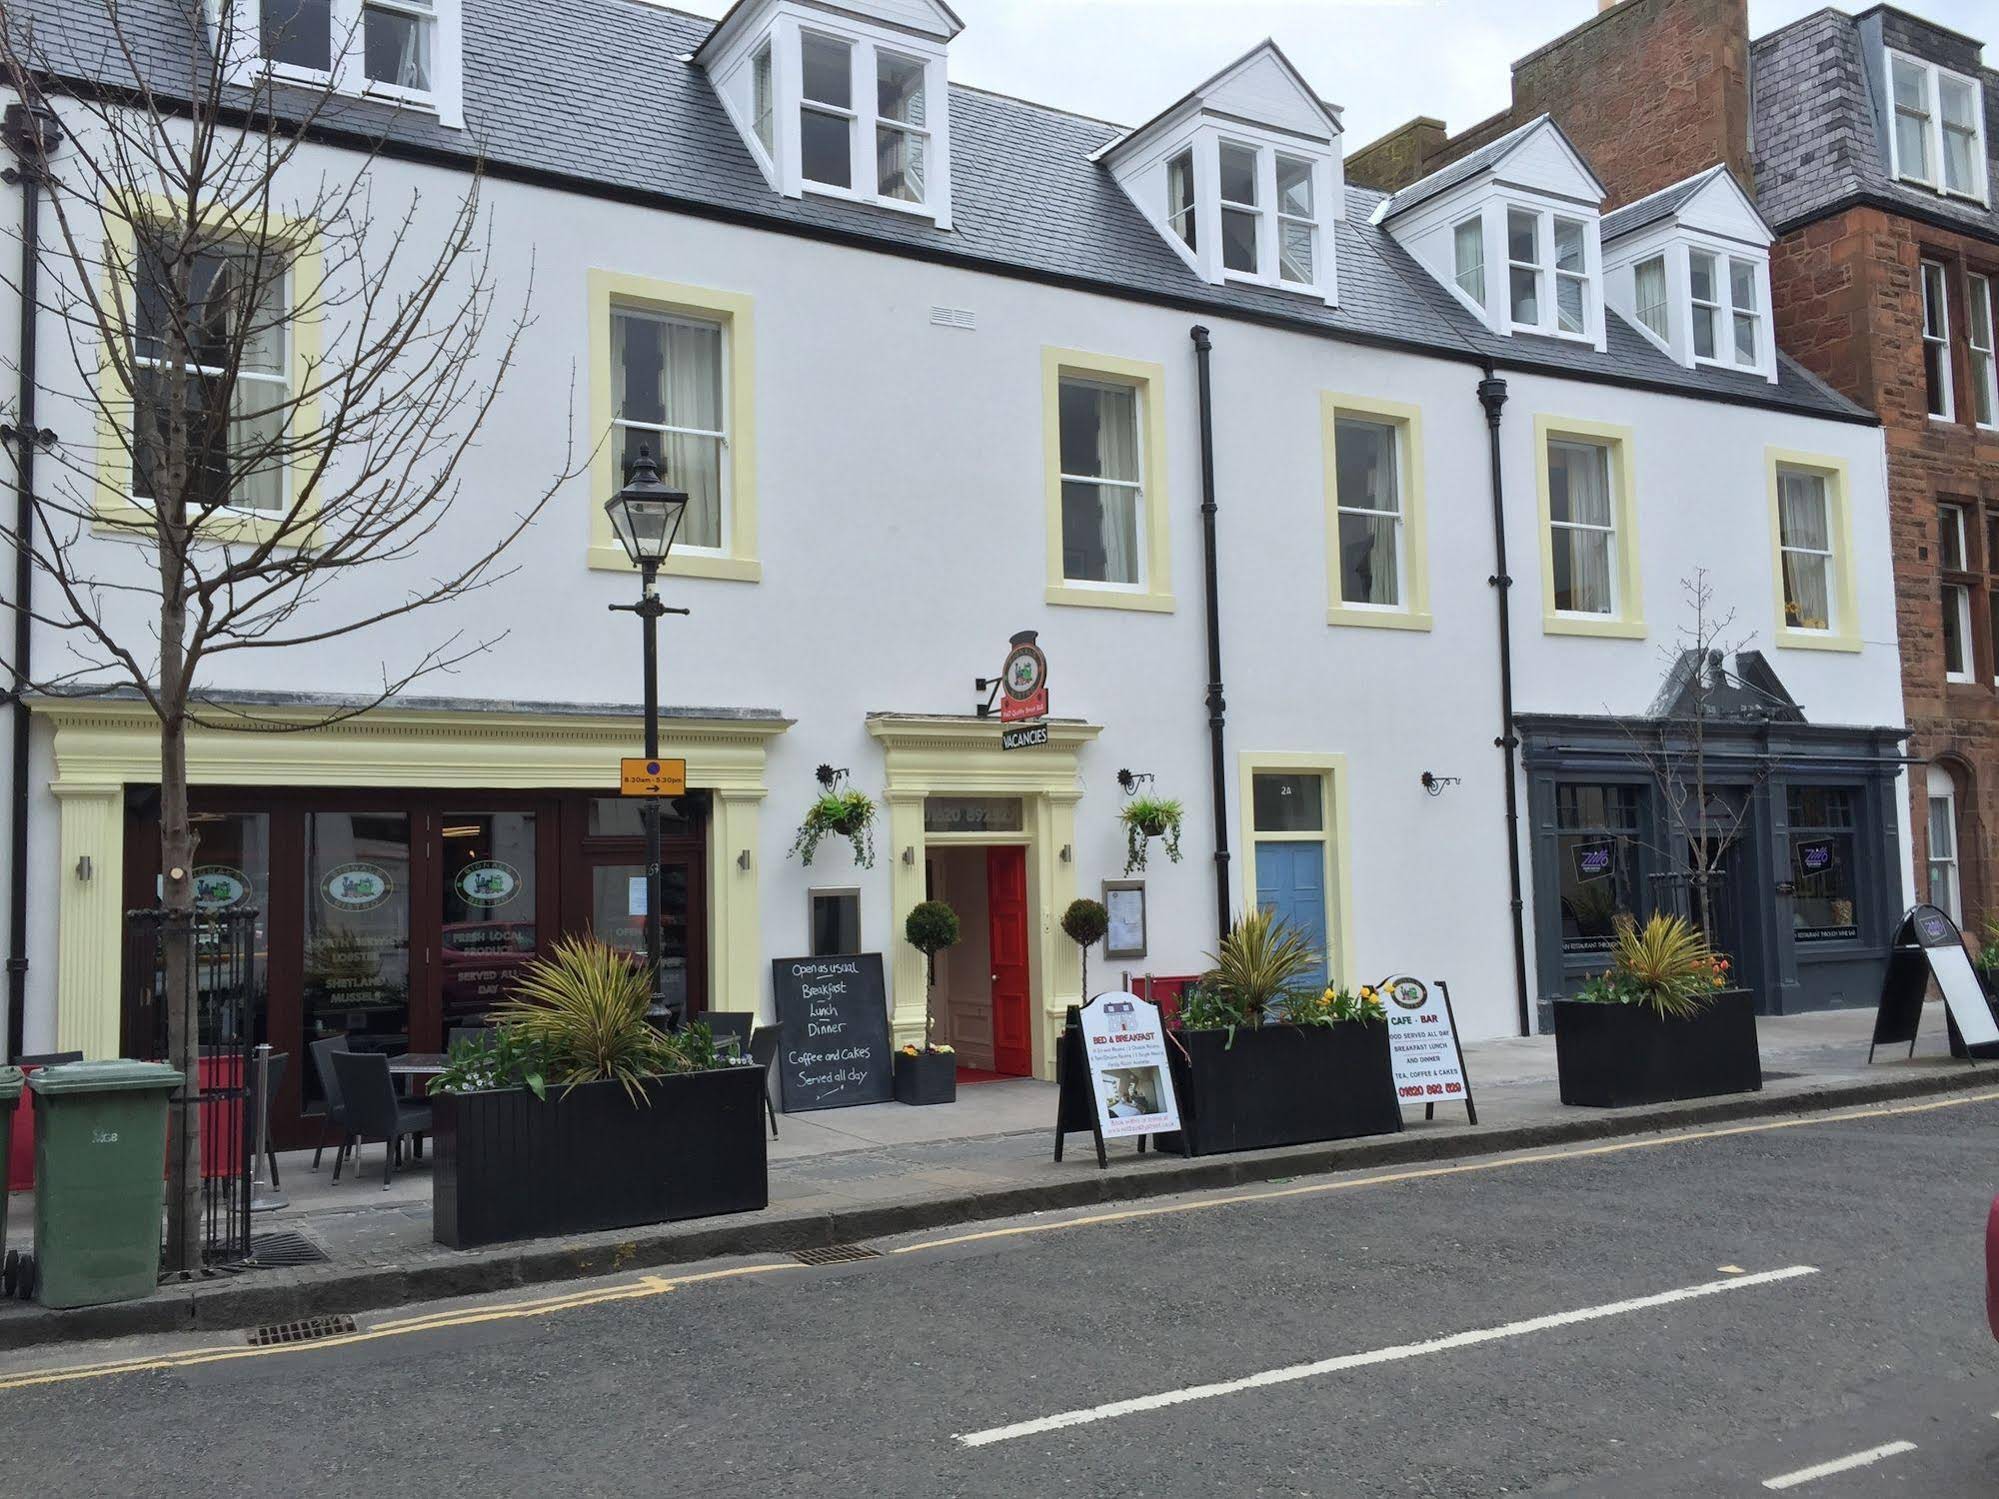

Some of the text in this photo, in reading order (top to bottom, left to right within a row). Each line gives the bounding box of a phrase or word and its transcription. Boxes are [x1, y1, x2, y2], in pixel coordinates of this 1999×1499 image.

[1003, 728, 1047, 748] VACANCIES
[1281, 786, 1292, 795] 2A
[489, 931, 523, 941] LOCAL
[458, 971, 497, 981] SERVED
[792, 962, 860, 979] Open as usual
[478, 984, 500, 994] DAY
[802, 981, 847, 1000] Breakfast
[810, 1003, 839, 1017] Lunch
[1391, 1014, 1439, 1025] CAFE BAR
[808, 1022, 847, 1037] Dinner
[1093, 1032, 1155, 1045] BED & BREAKFAST
[1394, 1042, 1448, 1052] BREAKFAST LUNCH
[788, 1051, 823, 1066] Coffee
[826, 1050, 840, 1061] and
[1420, 1055, 1441, 1063] DINNER
[797, 1069, 868, 1088] Served all day
[1410, 1070, 1432, 1078] COFFEE
[1439, 1068, 1459, 1076] CAKES
[1398, 1085, 1424, 1098] 01620
[1426, 1084, 1444, 1094] 892
